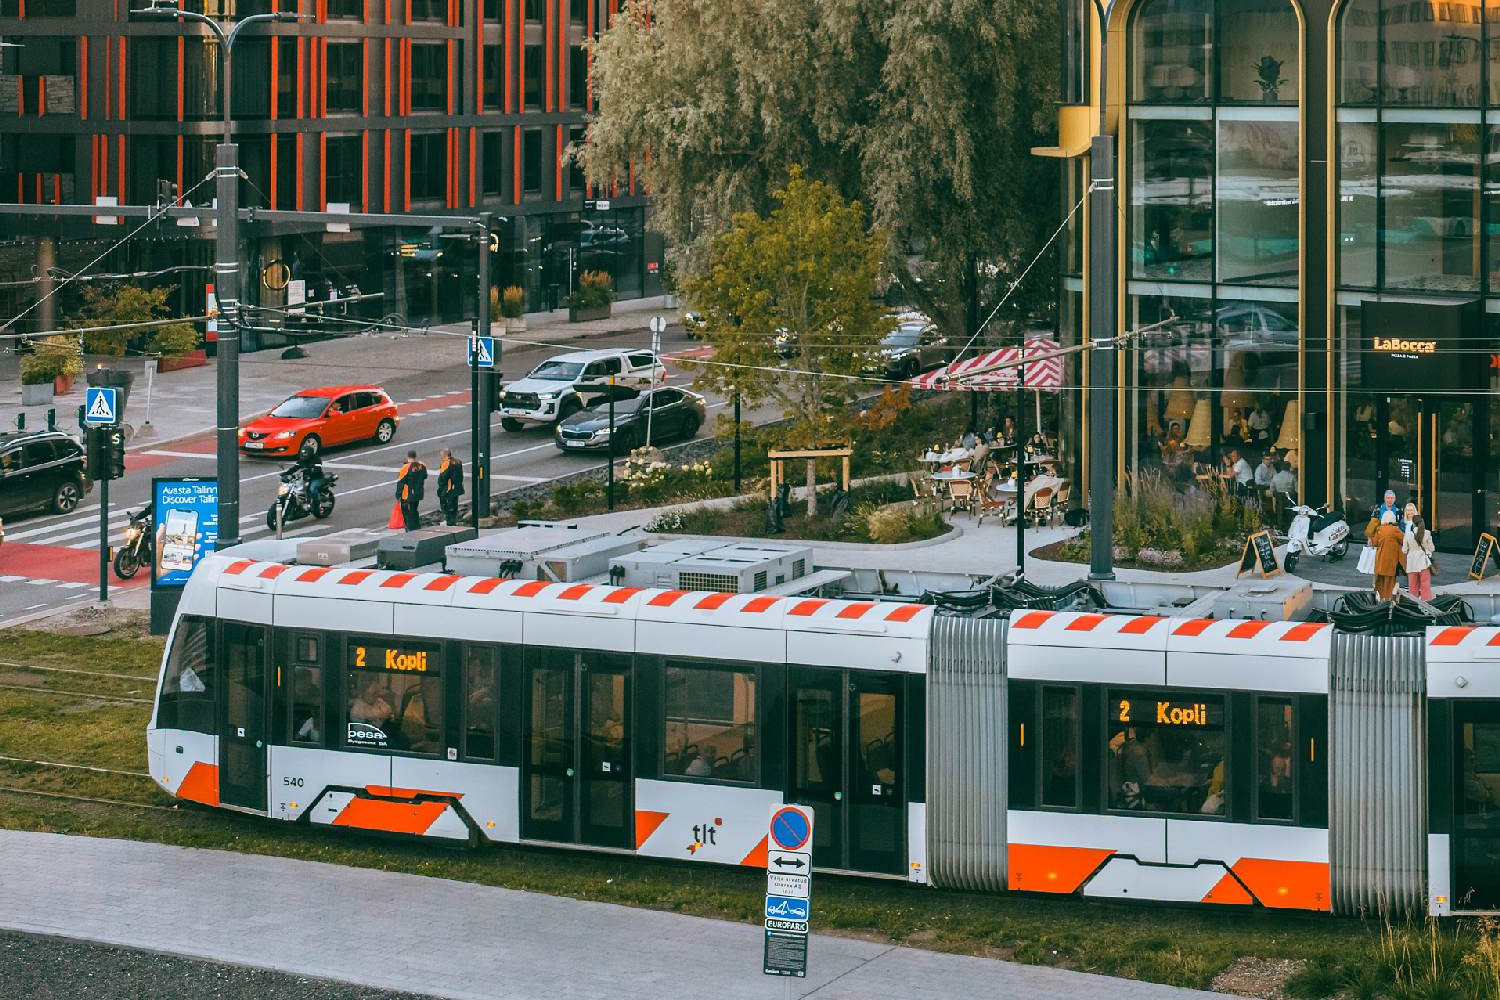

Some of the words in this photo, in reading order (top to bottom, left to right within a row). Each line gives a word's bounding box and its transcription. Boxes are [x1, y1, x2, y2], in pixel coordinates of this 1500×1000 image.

[1373, 336, 1436, 353] LaBocca
[162, 486, 192, 495] Avasta
[162, 495, 198, 505] Discover
[198, 494, 219, 504] Tallin
[355, 646, 367, 668] 2
[385, 648, 428, 672] Kopli
[1119, 699, 1131, 723] 2
[1156, 701, 1207, 726] Kopli
[347, 729, 387, 741] pesa
[282, 776, 305, 788] 540
[692, 823, 717, 846] tlt
[767, 919, 806, 932] EUROPARK
